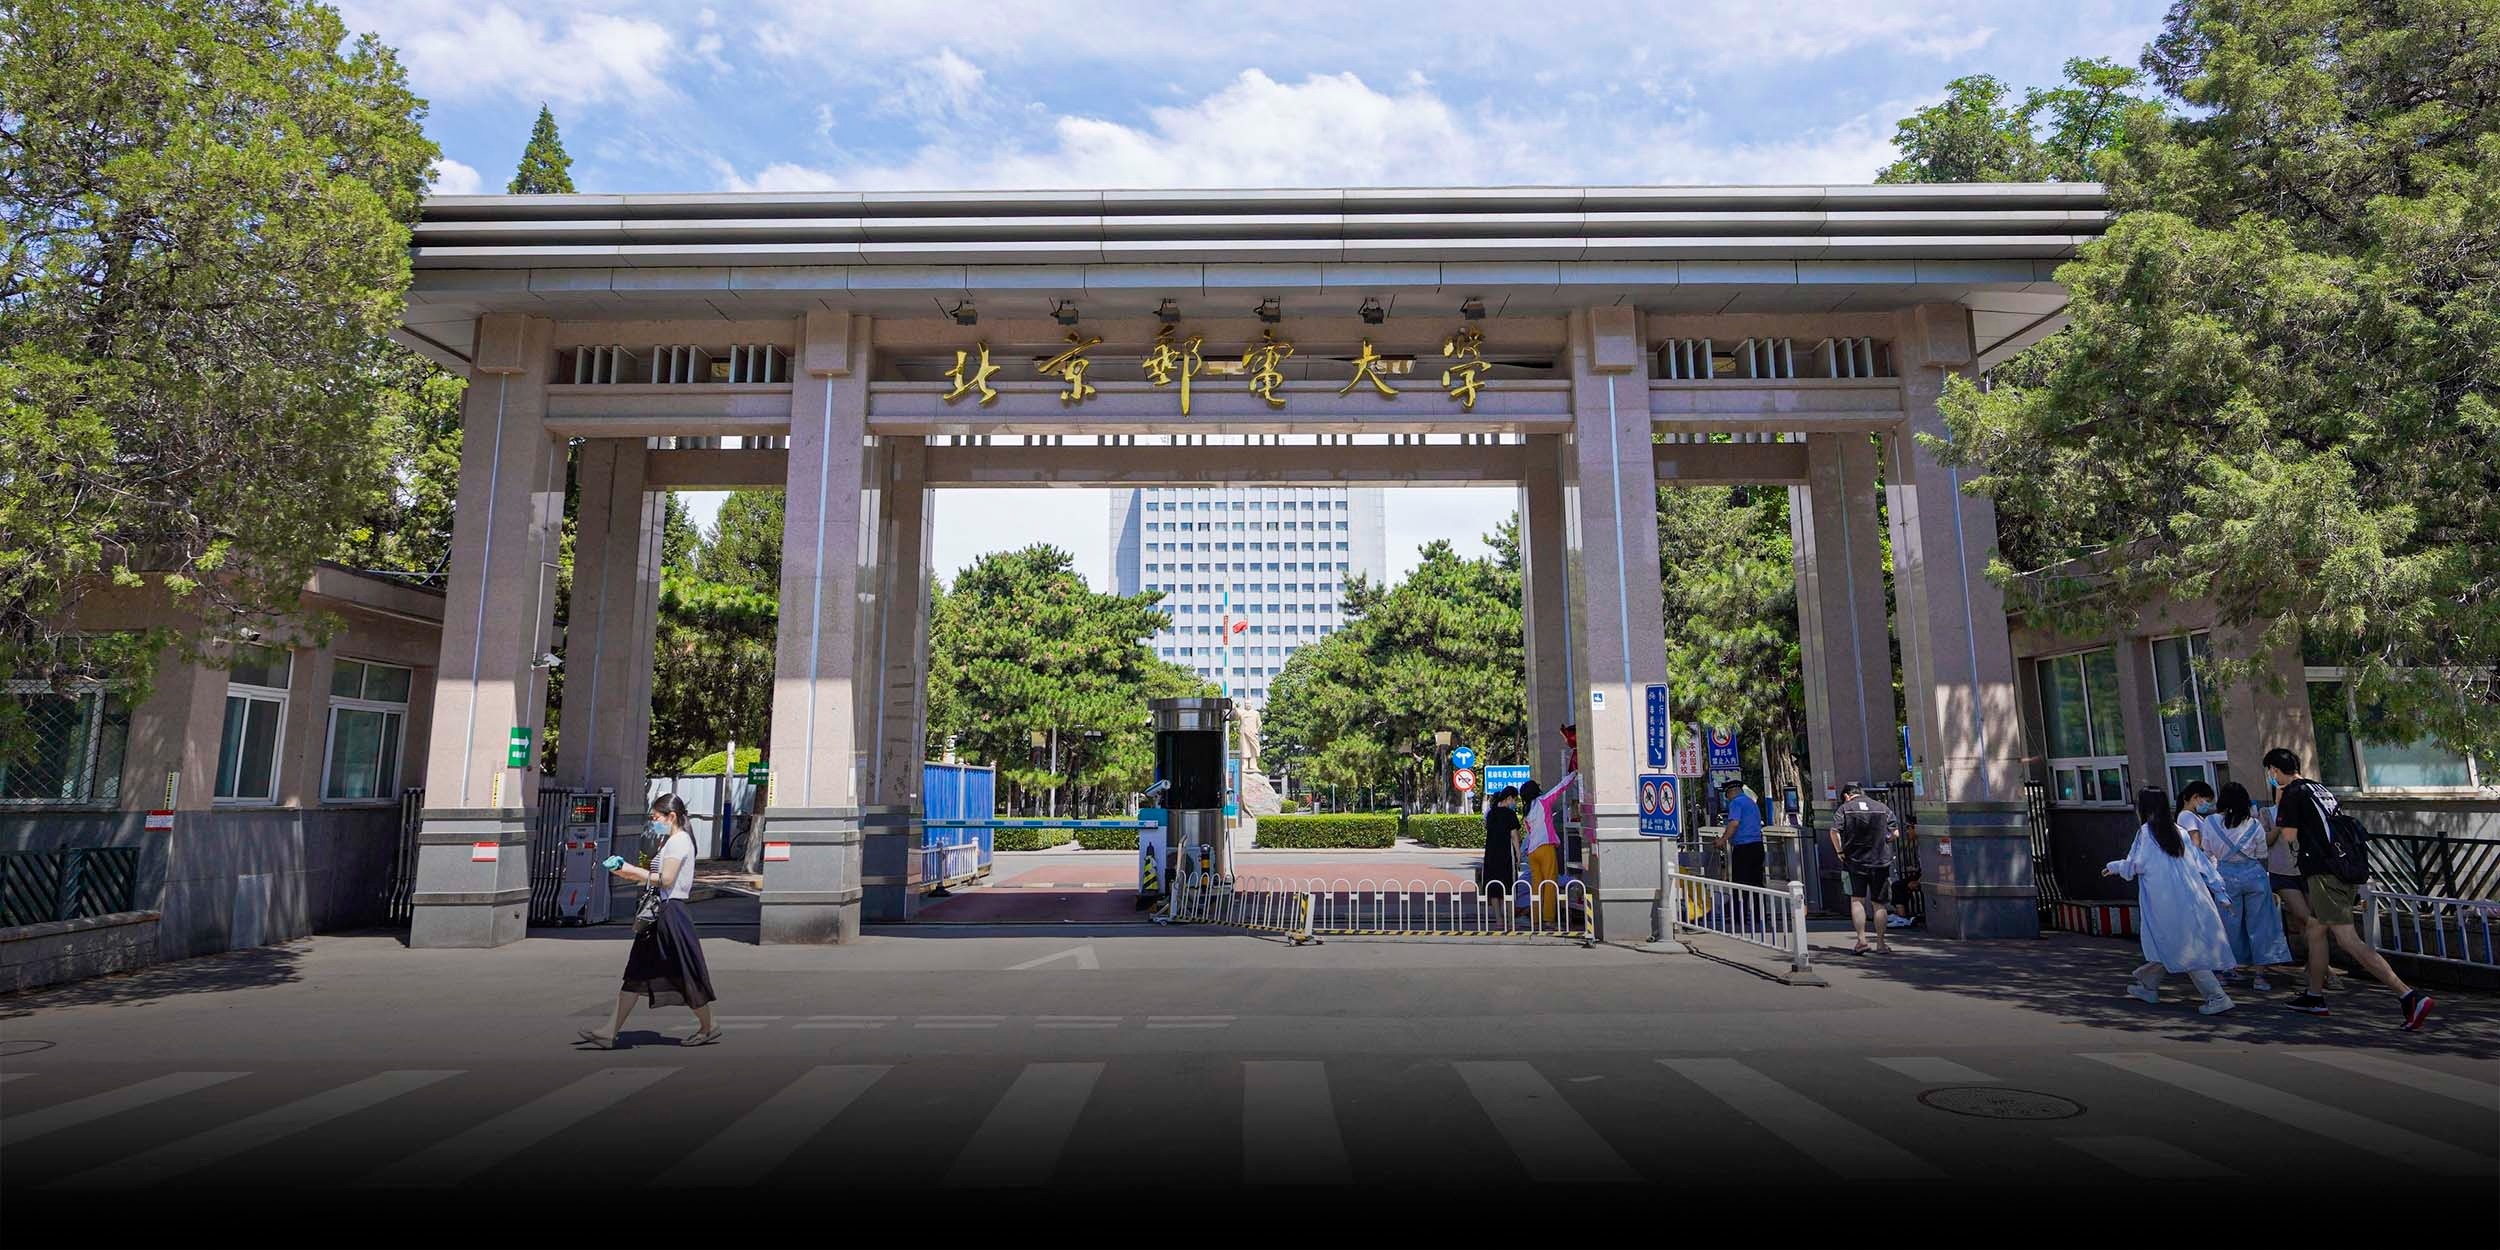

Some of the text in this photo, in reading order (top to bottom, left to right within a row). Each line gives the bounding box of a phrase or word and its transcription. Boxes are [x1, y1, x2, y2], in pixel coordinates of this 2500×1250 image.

[1714, 748, 1732, 756] 摩托车
[1712, 757, 1737, 765] 禁止入内
